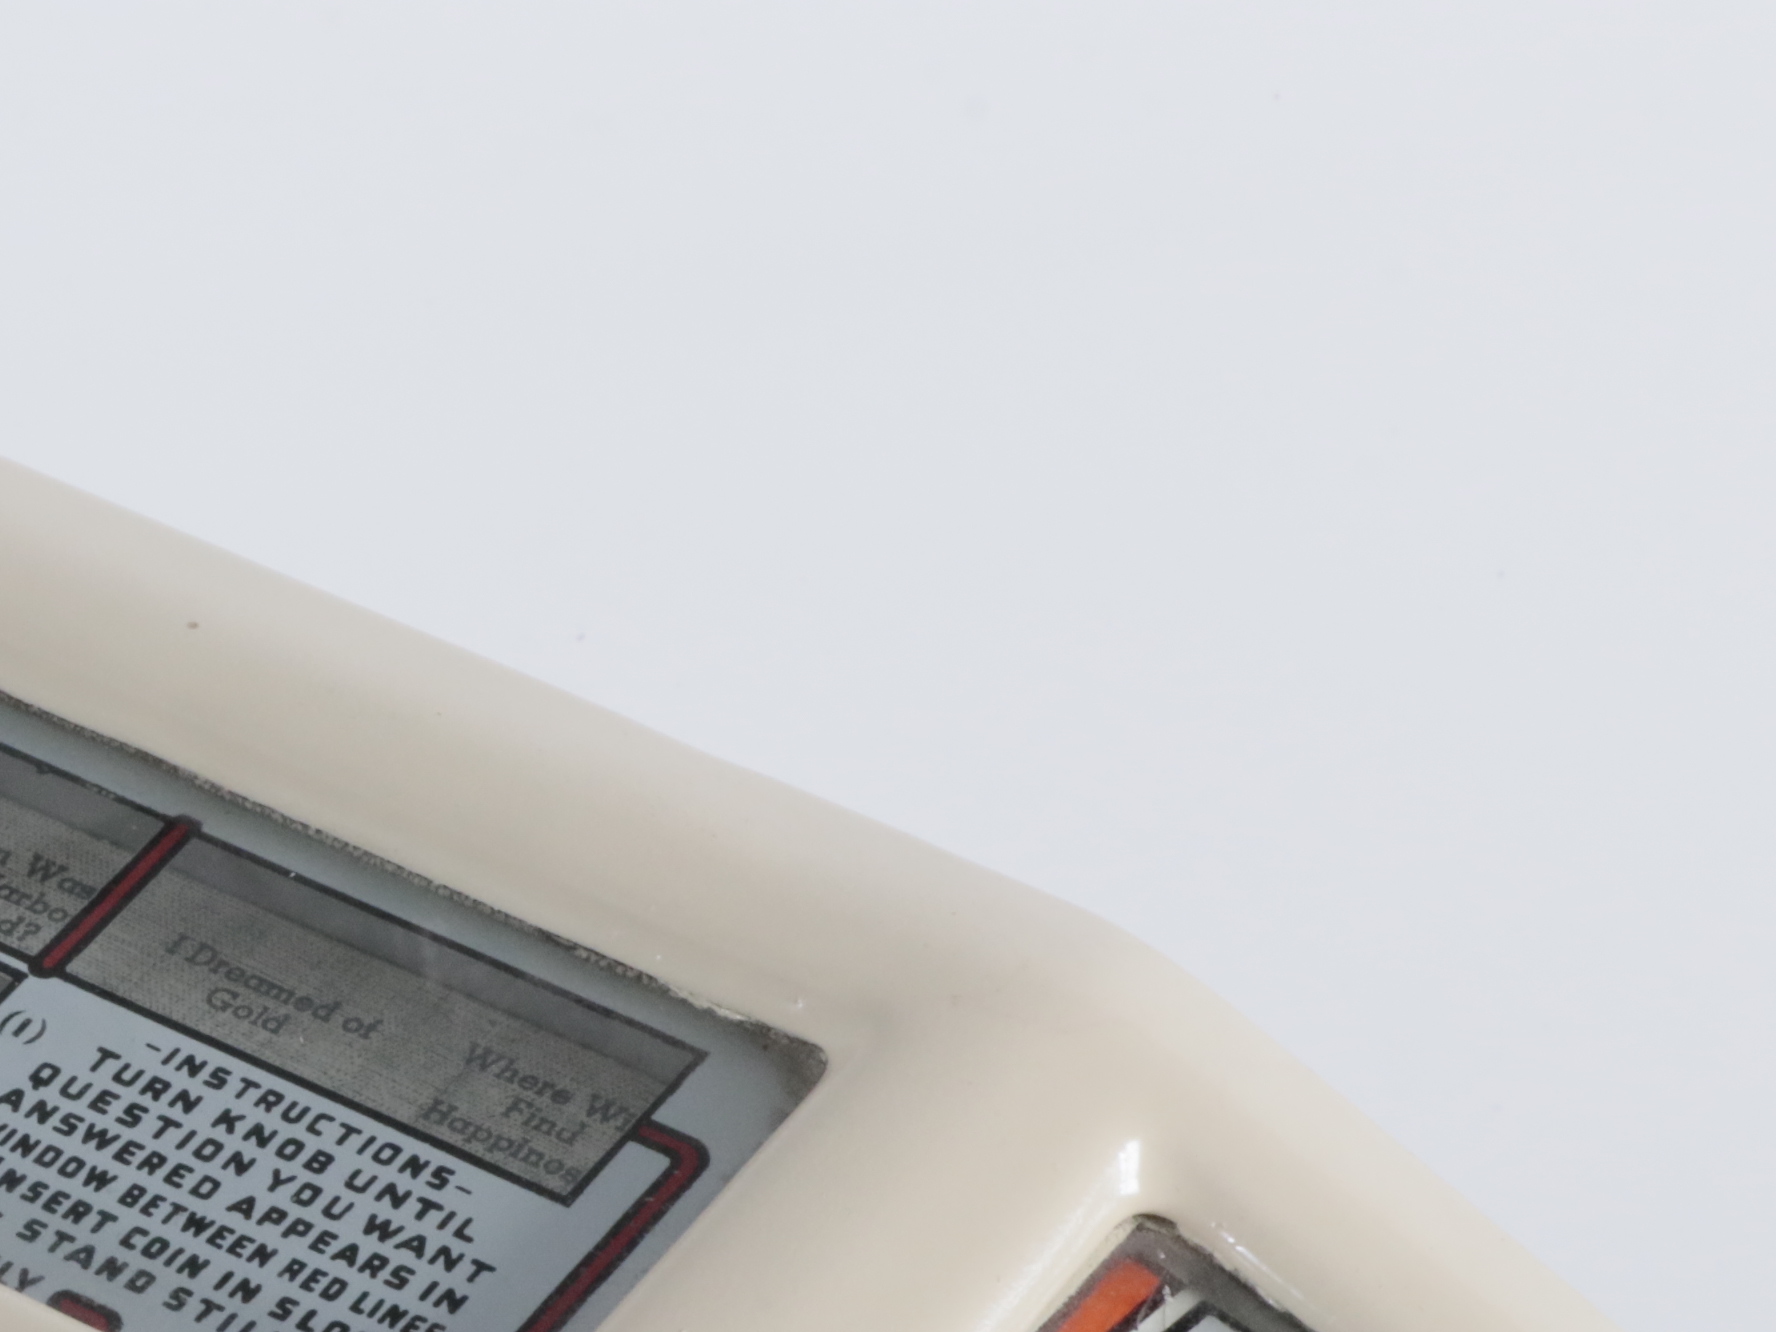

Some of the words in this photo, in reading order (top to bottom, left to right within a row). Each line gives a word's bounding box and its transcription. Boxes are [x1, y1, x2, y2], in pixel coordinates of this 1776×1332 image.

[184, 938, 342, 1023] Dreamed
[341, 1010, 387, 1040] of
[205, 985, 289, 1036] Gold
[463, 1041, 572, 1106] Where
[501, 1095, 591, 1147] Find
[28, 1062, 256, 1176] QUESTION
[267, 1168, 355, 1222] YOU
[362, 1213, 497, 1283] WANT
[89, 1046, 204, 1115] TURN
[211, 1108, 335, 1175] KNOB
[344, 1168, 474, 1244] UNTIL
[117, 1183, 279, 1269] BETWEEN
[277, 1258, 349, 1302] RED
[119, 1226, 211, 1279] COIN
[213, 1270, 263, 1304] IN
[226, 1195, 416, 1292] APPEARS
[419, 1281, 469, 1315] IN
